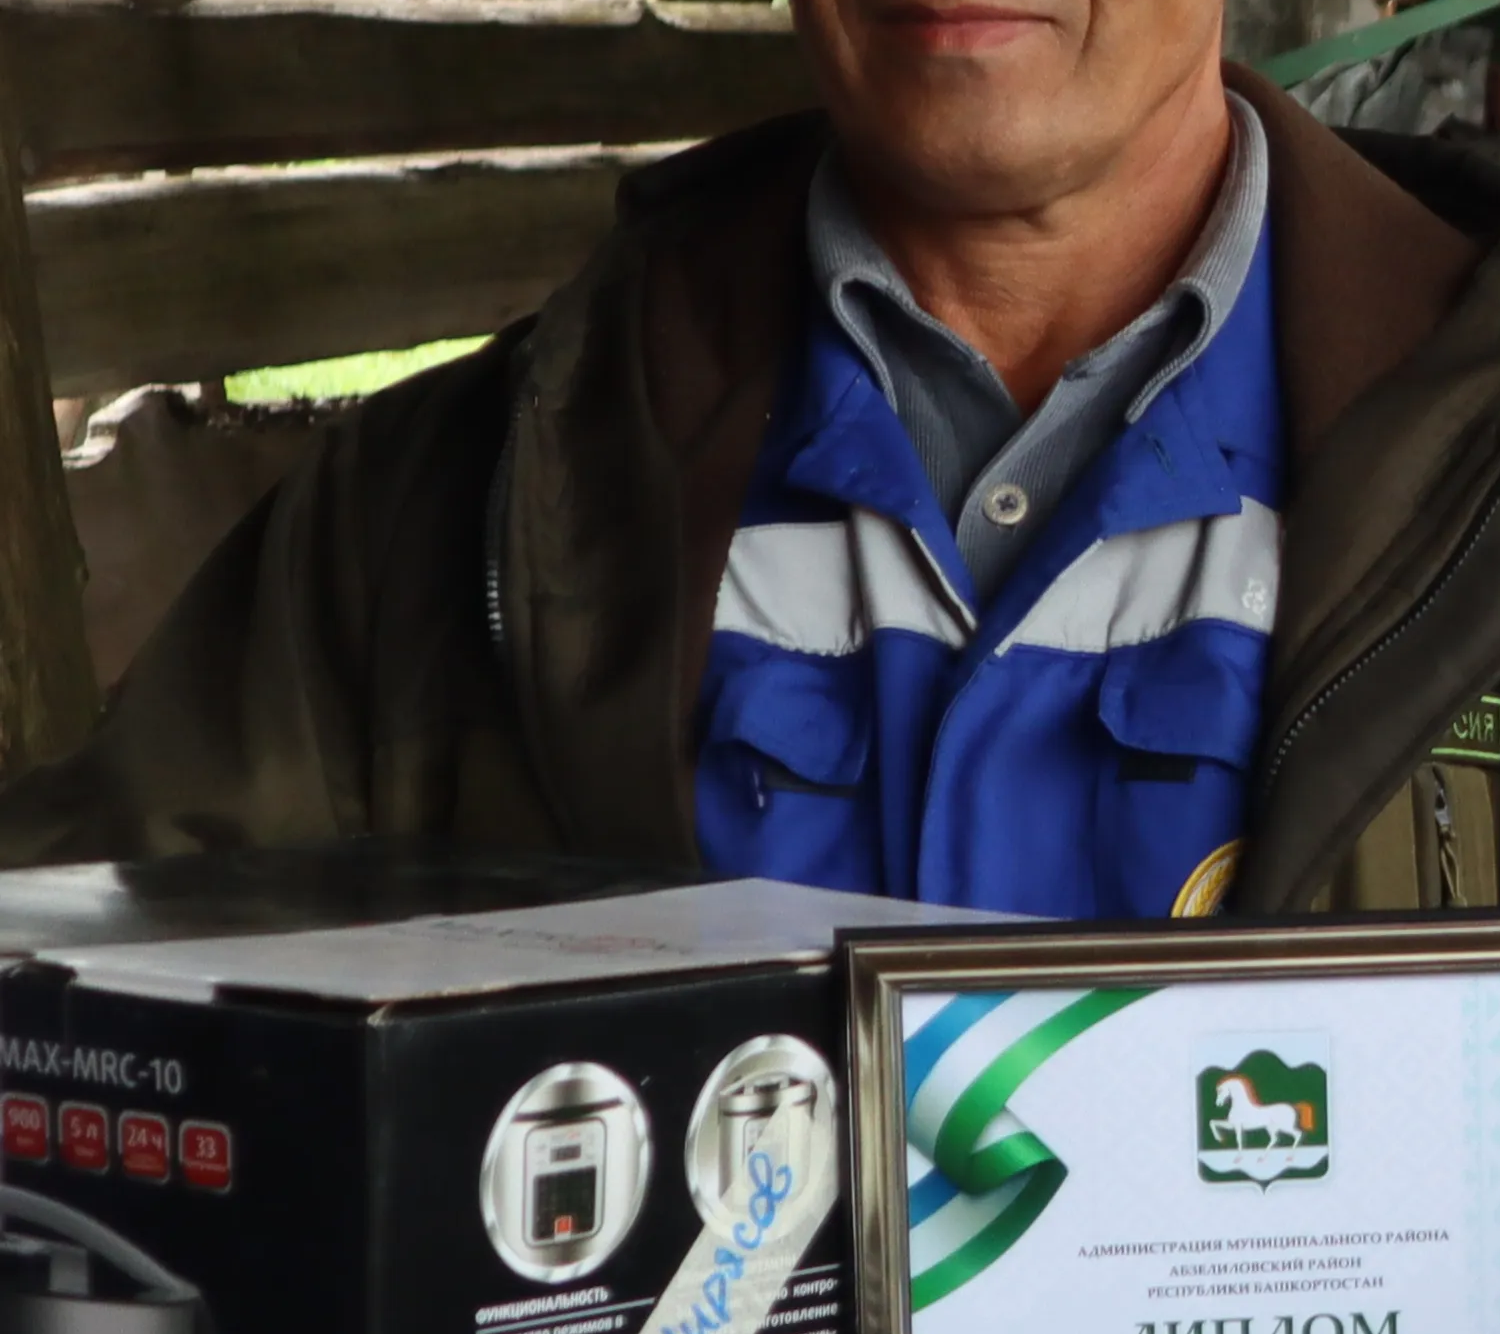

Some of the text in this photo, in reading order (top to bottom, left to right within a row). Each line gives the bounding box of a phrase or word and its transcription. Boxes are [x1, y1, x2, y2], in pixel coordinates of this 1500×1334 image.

[1077, 1229, 1450, 1259] АДМИНИСТРАЦИЯ МУНИЦИПАЛЬНОГО РАЙОНА
[475, 1287, 609, 1324] ФУНКЦИОНАЛЬНОСТЬ
